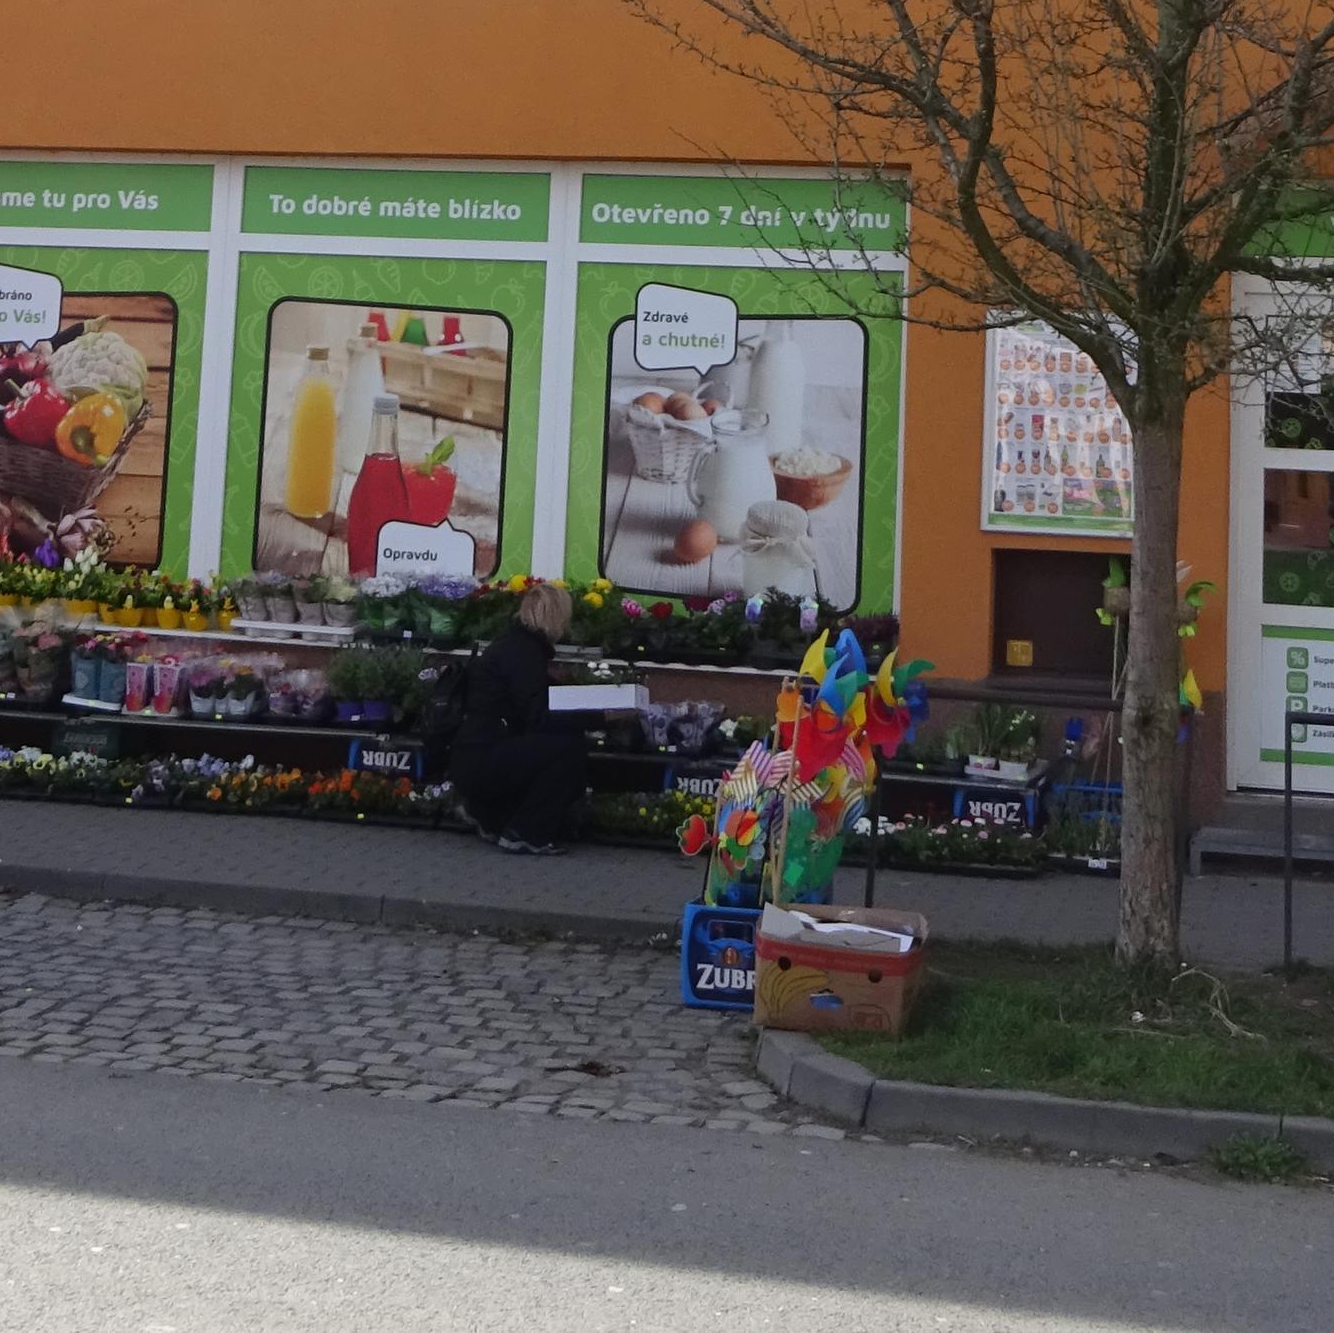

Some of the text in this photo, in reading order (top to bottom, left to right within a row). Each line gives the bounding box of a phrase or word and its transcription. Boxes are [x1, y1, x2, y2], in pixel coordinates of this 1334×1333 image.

[42, 188, 66, 209] tu
[73, 193, 111, 213] pro
[118, 189, 159, 211] Vás
[270, 194, 522, 221] To dobré máte blízko
[592, 201, 891, 233] Otevřeno 7 dní v týdnu
[13, 308, 47, 324] Vás!
[643, 310, 689, 324] Zdravé
[642, 332, 725, 349] a chutné!
[383, 547, 438, 563] Opravdu
[362, 750, 411, 770] ZUBR
[968, 800, 1021, 822] ZUBR
